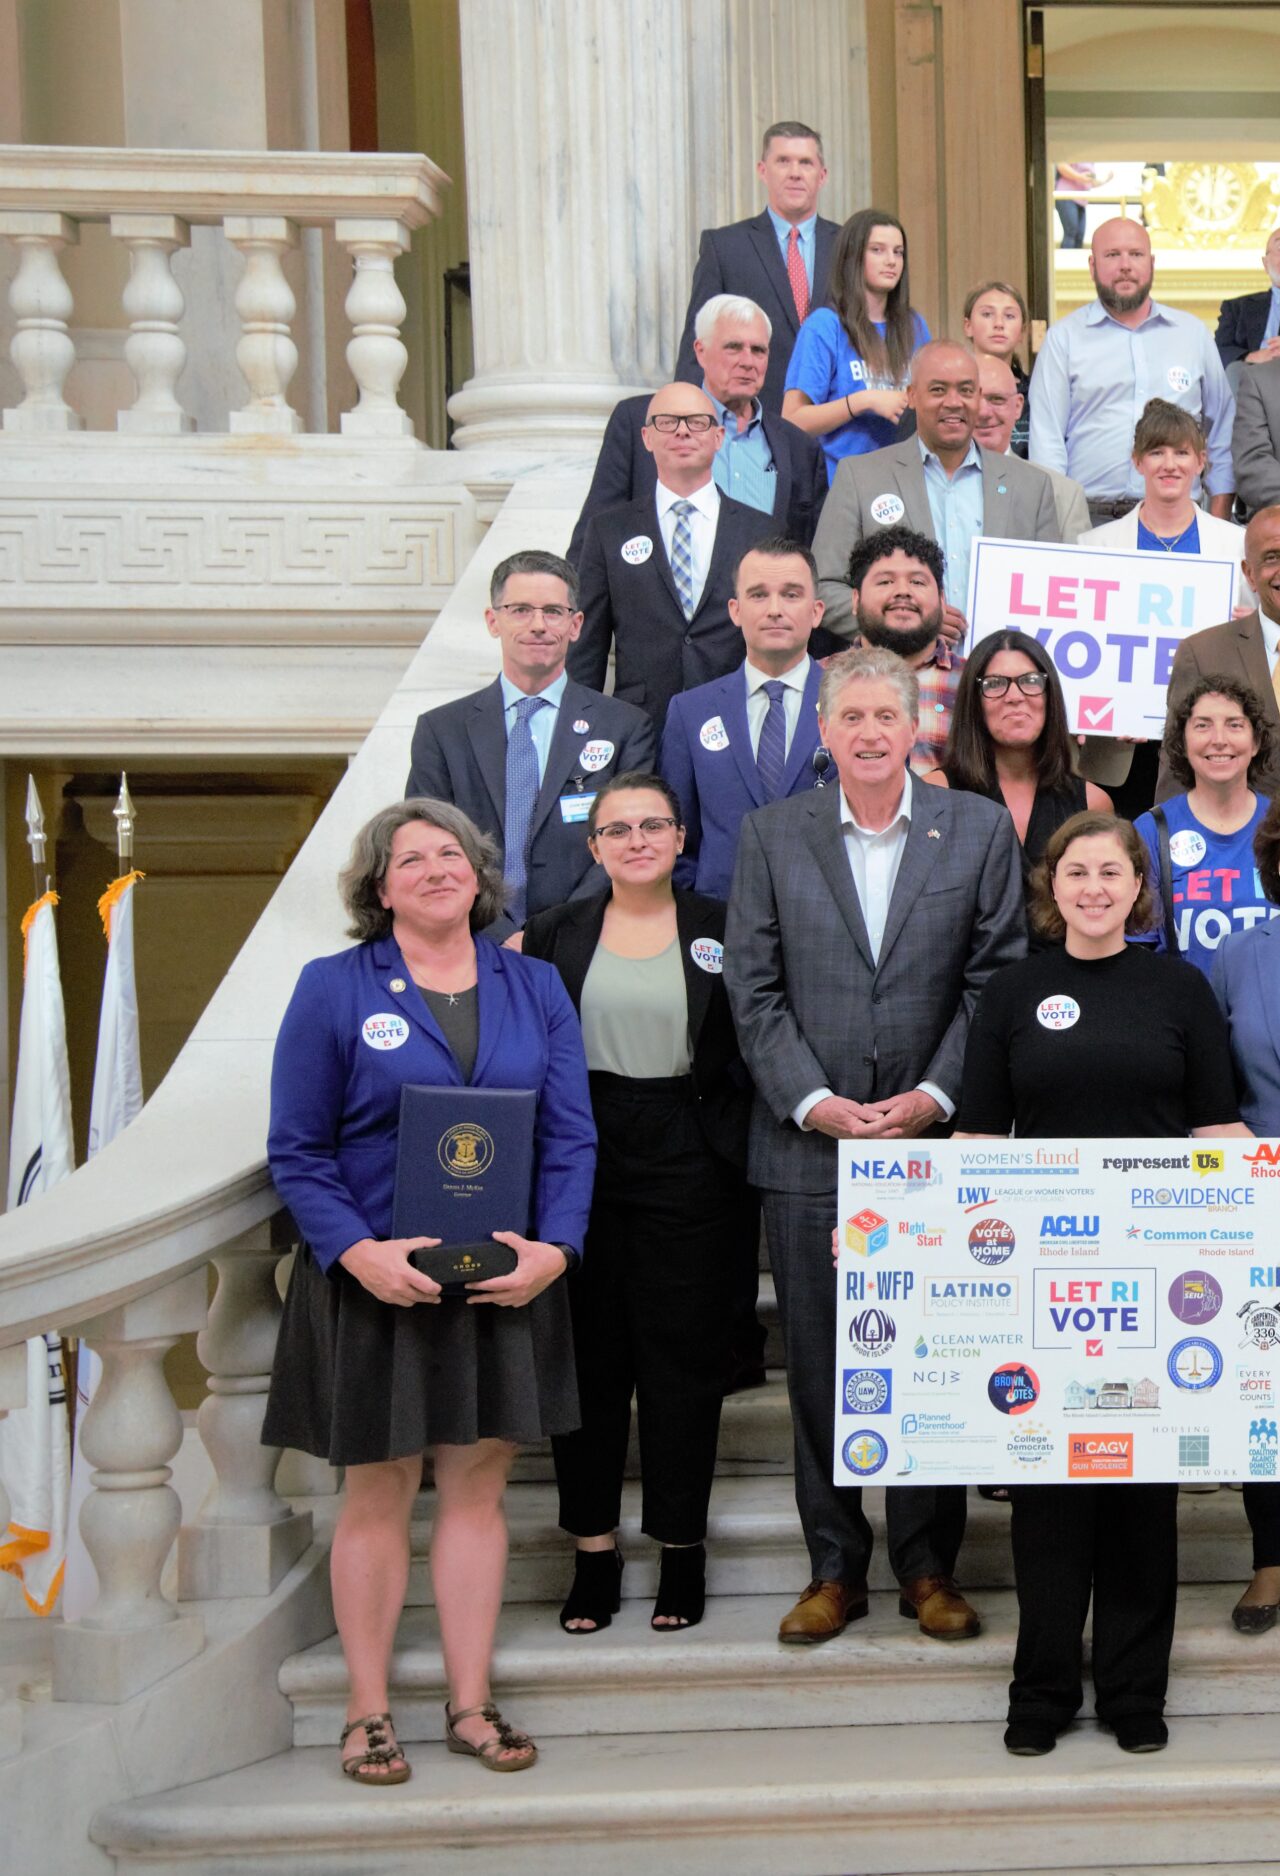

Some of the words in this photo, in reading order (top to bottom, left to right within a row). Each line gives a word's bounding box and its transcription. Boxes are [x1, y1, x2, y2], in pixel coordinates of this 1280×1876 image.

[876, 504, 901, 520] VOTE
[625, 547, 650, 557] VOTE
[1009, 572, 1120, 621] LET
[1137, 583, 1195, 627] RI
[704, 732, 724, 744] VOT
[582, 752, 610, 762] VOTE
[694, 943, 712, 953] LET
[1041, 1003, 1062, 1011] LET
[1042, 1010, 1076, 1020] VOTE
[364, 1021, 386, 1030] LET
[366, 1028, 404, 1040] VOTE
[960, 1153, 1033, 1164] WOMEN'S
[1036, 1148, 1080, 1164] fund
[1102, 1154, 1190, 1172] represent
[1196, 1154, 1220, 1169] Us
[851, 1160, 932, 1180] NEARI
[958, 1187, 990, 1204] LWV
[1132, 1188, 1255, 1205] PROVIDENCE
[1208, 1204, 1238, 1212] BRANCH
[1040, 1216, 1100, 1236] ACLU
[976, 1228, 1008, 1238] VOTE
[1144, 1229, 1207, 1240] Common
[1210, 1229, 1254, 1240] Cause
[916, 1234, 942, 1247] Start
[986, 1238, 998, 1246] at
[974, 1246, 1010, 1256] HOME
[1040, 1247, 1068, 1256] Rhode
[1072, 1247, 1100, 1256] Island
[1199, 1248, 1226, 1256] Rhode
[1228, 1248, 1254, 1256] Island
[846, 1272, 864, 1301] RI
[877, 1271, 914, 1300] WFP
[930, 1282, 1012, 1298] LATINO
[1050, 1281, 1102, 1302] LET
[1112, 1281, 1138, 1302] RI
[930, 1299, 964, 1308] POLICY
[966, 1298, 1012, 1307] INSTITUTE
[1050, 1307, 1138, 1332] VOTE
[849, 1308, 896, 1342] NOW
[1254, 1328, 1276, 1338] 330
[932, 1334, 974, 1344] CLEAN
[979, 1334, 1024, 1344] WATER
[852, 1343, 870, 1358] RHODE
[871, 1343, 893, 1358] ISLAND
[932, 1348, 981, 1358] ACTION
[858, 1388, 875, 1396] UAW
[1152, 1426, 1211, 1434] HOUSING
[1014, 1435, 1048, 1444] College
[1073, 1442, 1128, 1454] RICAGV
[1178, 1469, 1238, 1477] NETWORK
